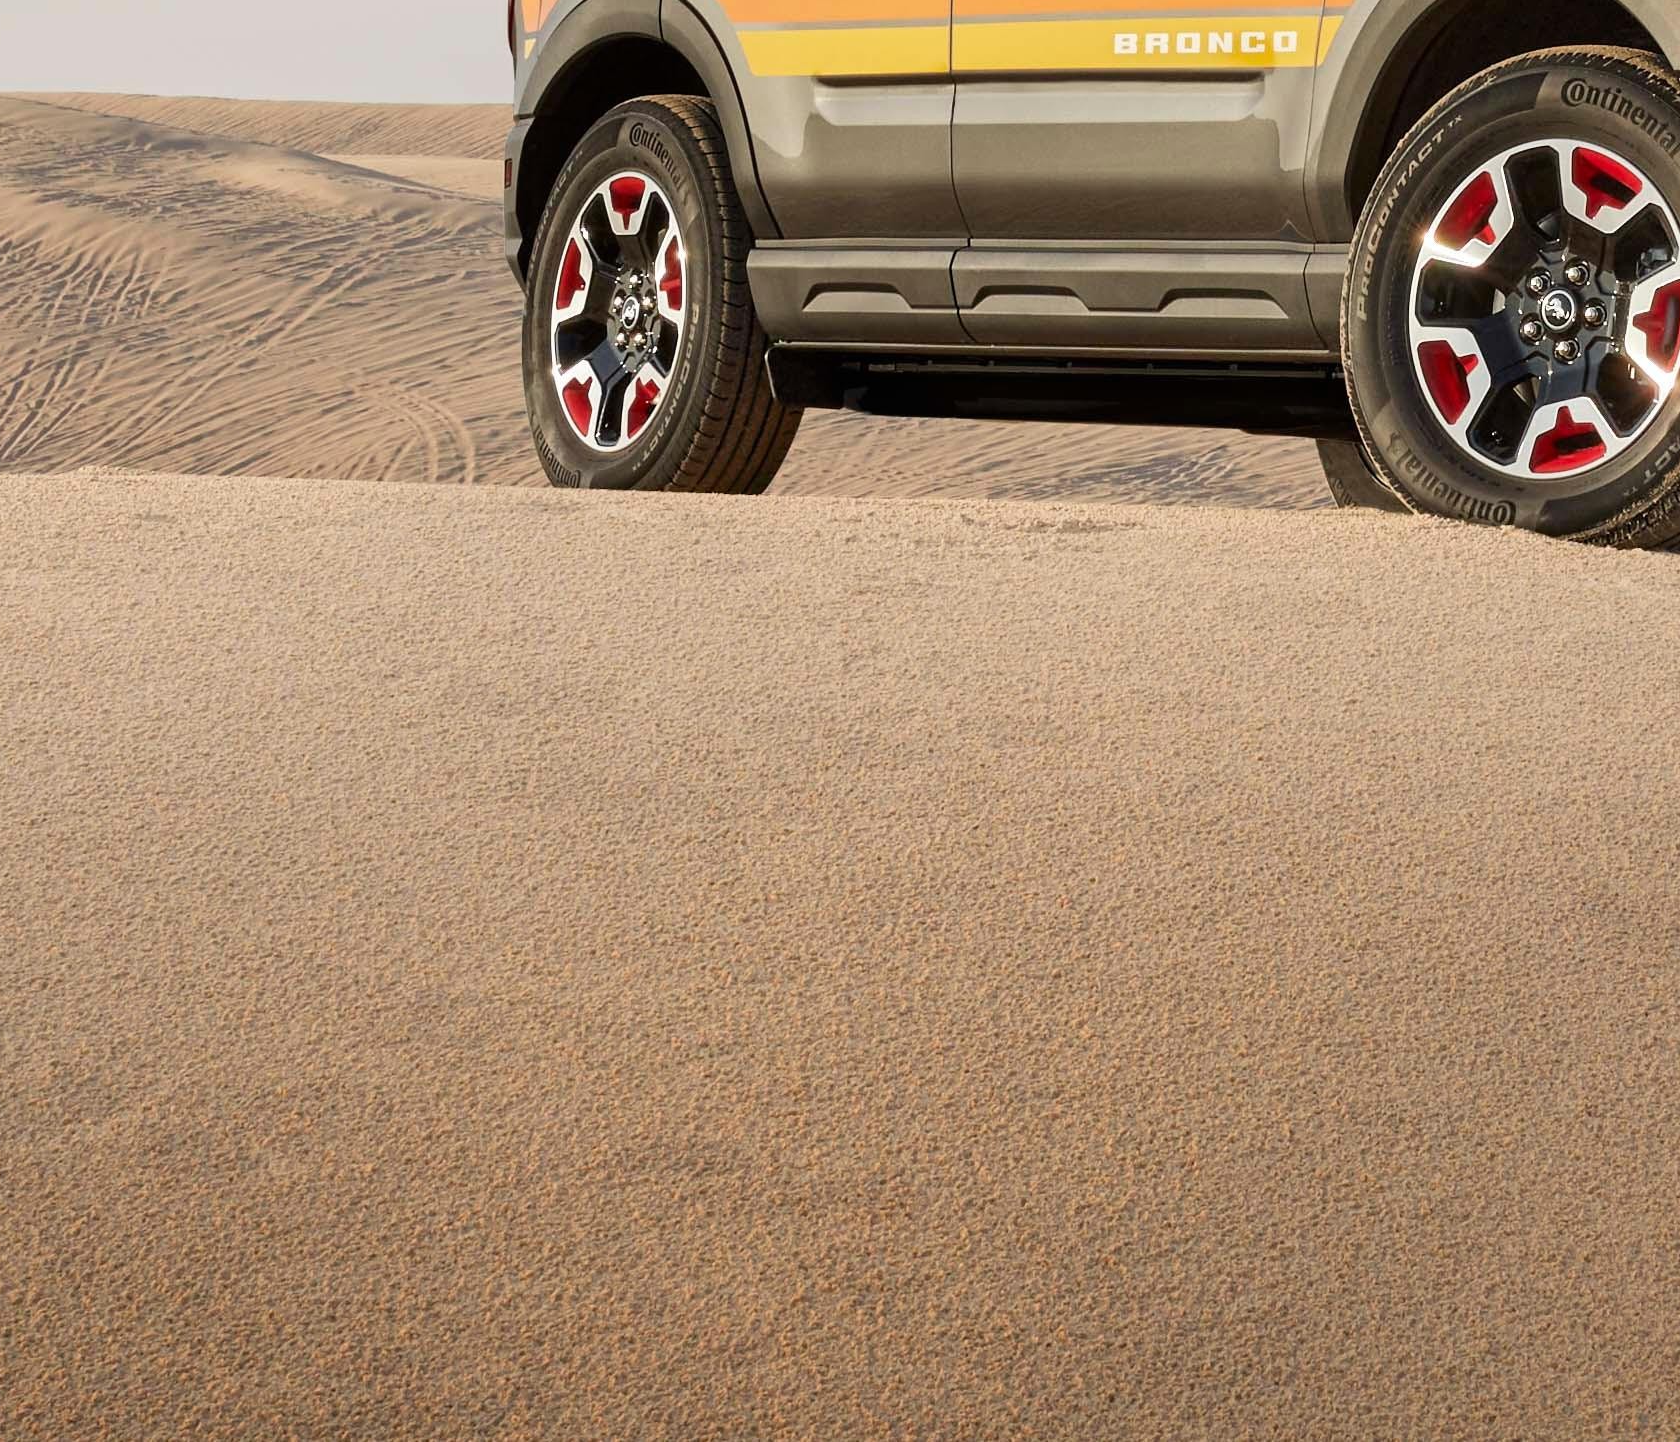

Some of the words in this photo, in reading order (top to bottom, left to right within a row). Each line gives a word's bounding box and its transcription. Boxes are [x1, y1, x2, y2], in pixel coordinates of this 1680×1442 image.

[1114, 31, 1297, 54] BRONCO
[629, 122, 686, 192] Continental
[1395, 447, 1517, 525] Continental
